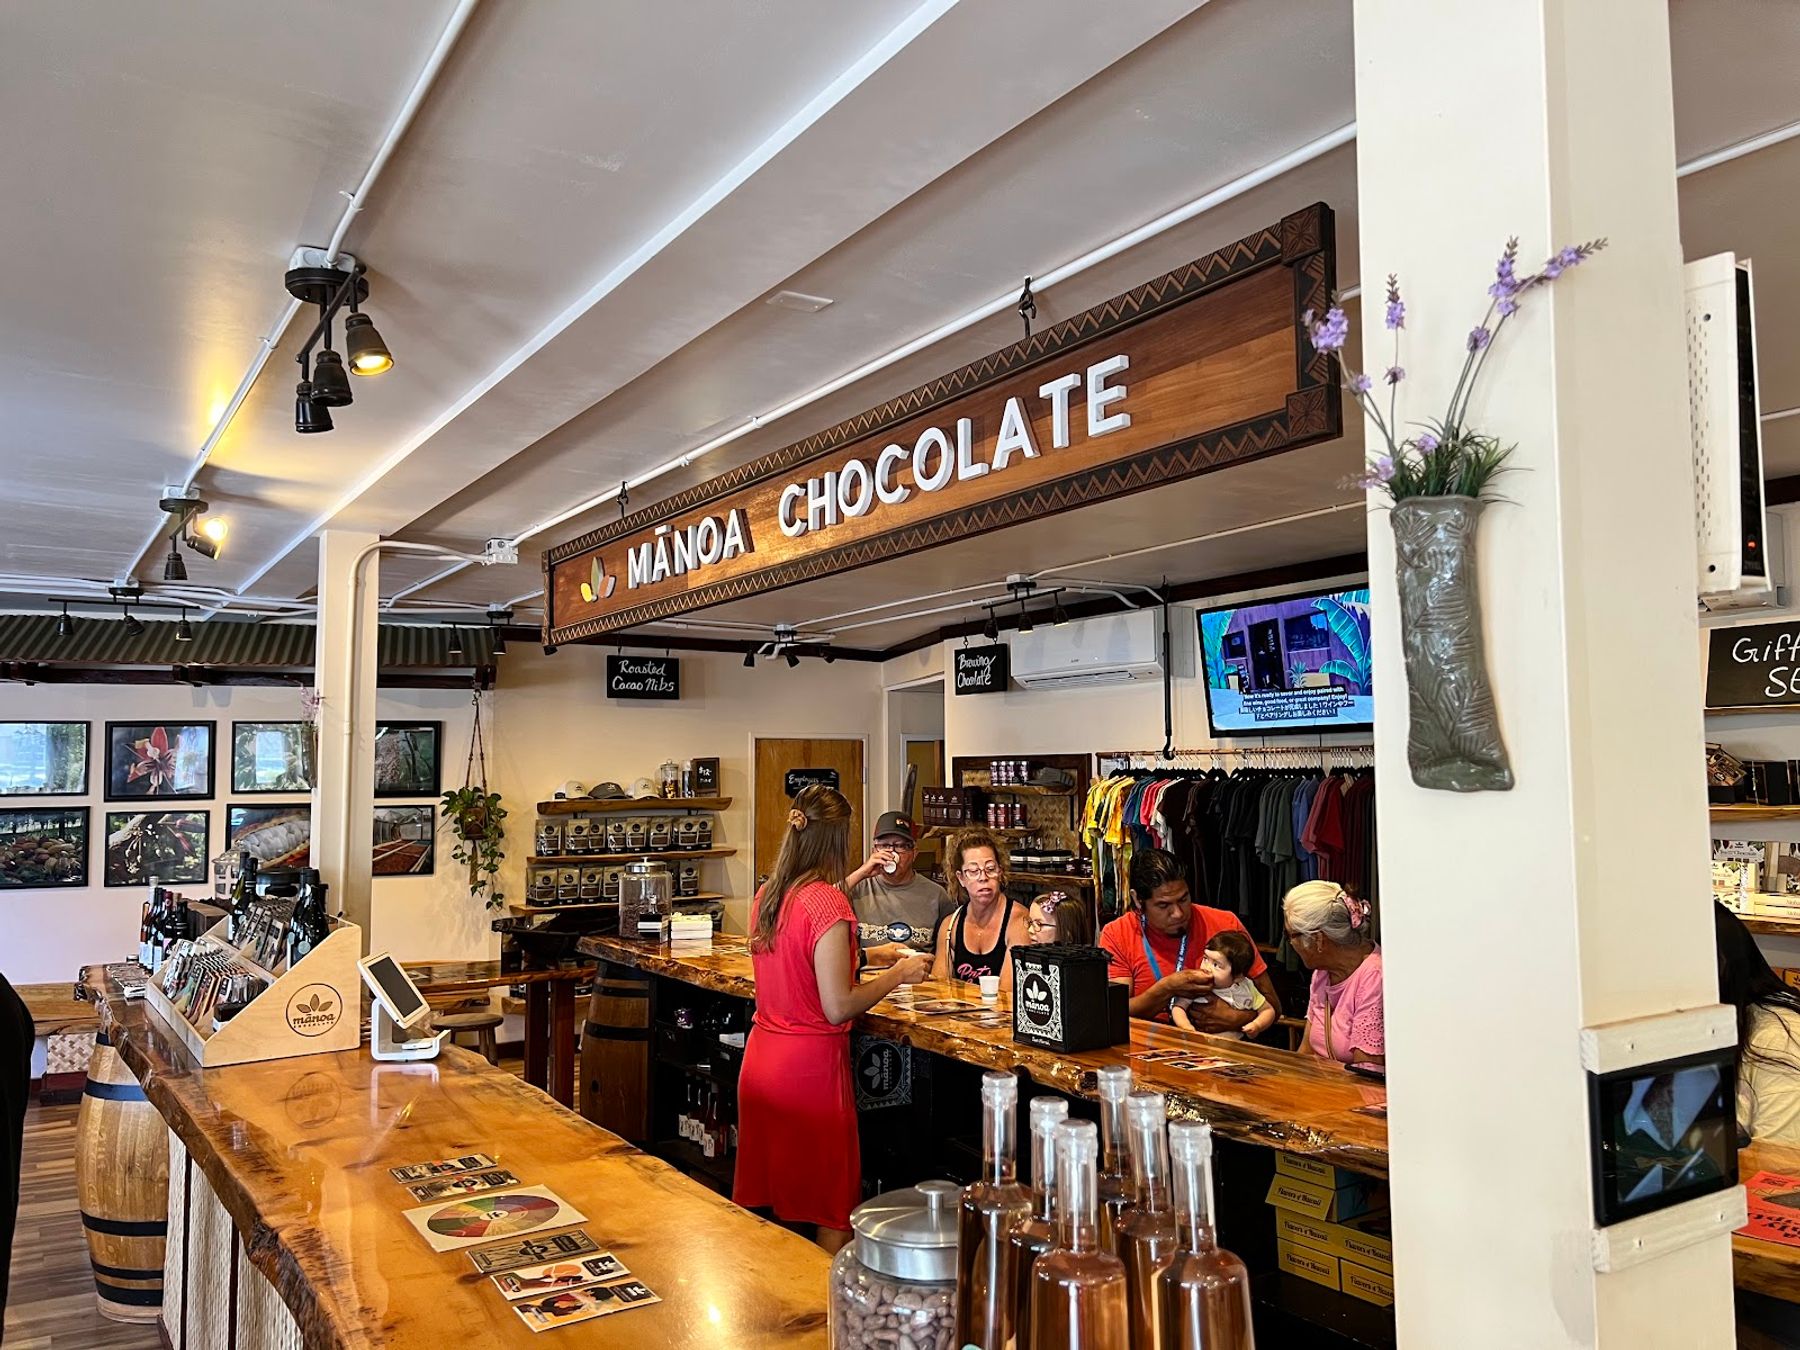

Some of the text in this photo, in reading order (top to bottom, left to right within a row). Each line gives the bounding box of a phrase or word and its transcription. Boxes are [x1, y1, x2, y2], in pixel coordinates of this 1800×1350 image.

[627, 354, 1131, 589] MĀNOA CHOCOLATE
[619, 660, 667, 676] Roasted
[612, 675, 675, 692] Cacao Nibs
[293, 1013, 335, 1024] mānoa
